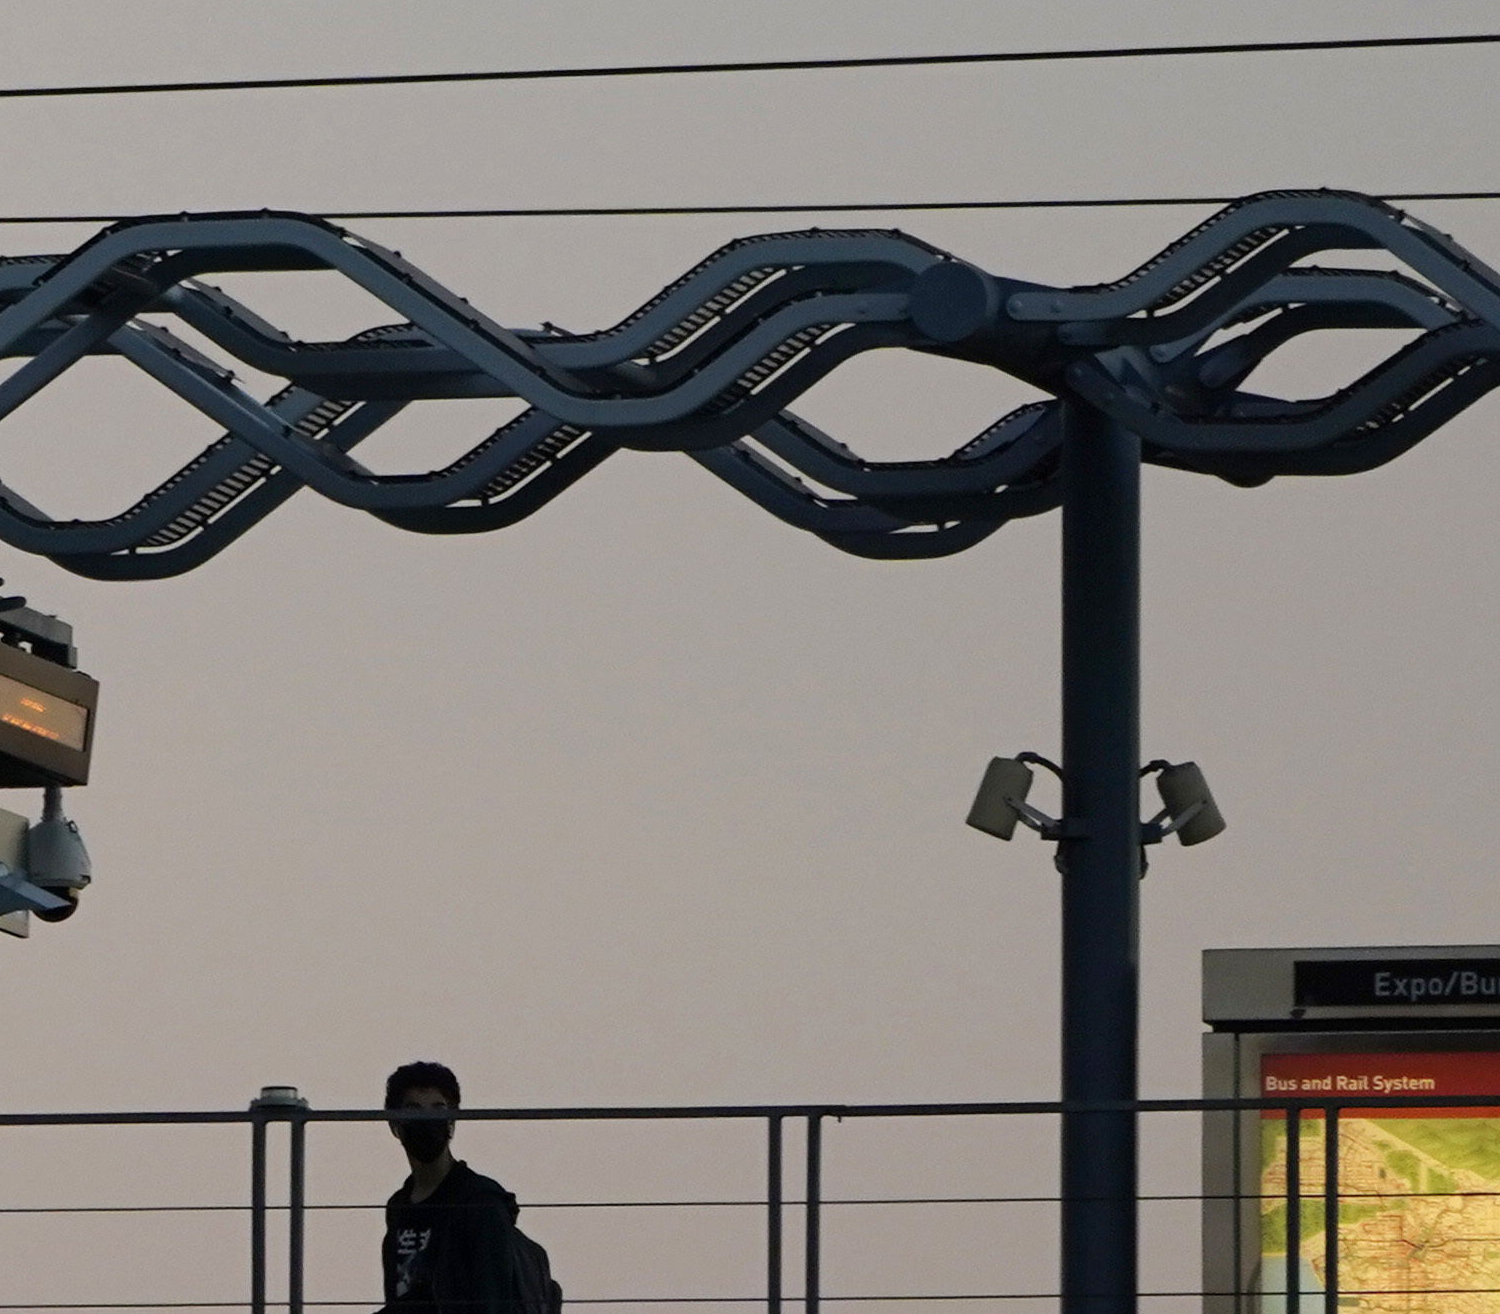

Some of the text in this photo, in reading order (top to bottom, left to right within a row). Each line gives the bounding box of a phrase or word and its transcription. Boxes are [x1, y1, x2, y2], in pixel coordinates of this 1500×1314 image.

[1373, 970, 1500, 1002] Expo/Bu
[1265, 1075, 1436, 1094] Bus and Rail System
